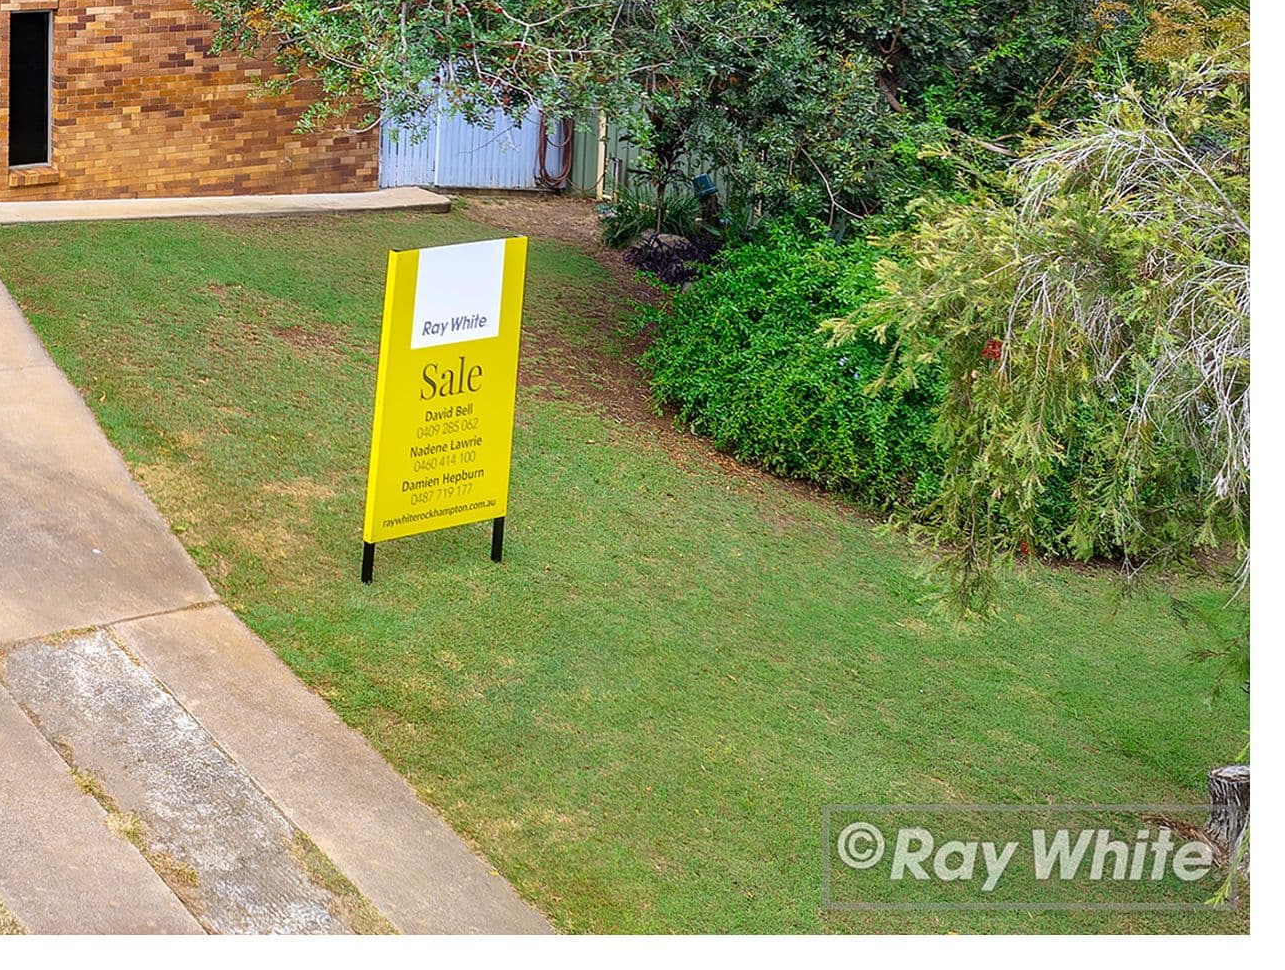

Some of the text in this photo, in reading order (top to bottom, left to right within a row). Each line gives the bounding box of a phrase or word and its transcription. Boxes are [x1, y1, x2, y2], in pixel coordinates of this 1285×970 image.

[422, 314, 487, 337] Ray White
[420, 356, 483, 401] Sale
[425, 403, 473, 422] David Bell
[416, 417, 479, 439] 0409 285 062
[410, 435, 482, 458] Nadene Lawrie
[413, 451, 476, 473] 0460 414 100
[402, 468, 485, 492] Damien Hepburn
[410, 484, 473, 506] 0487 719 177
[382, 499, 496, 528] raywhiterockhampton.com.au
